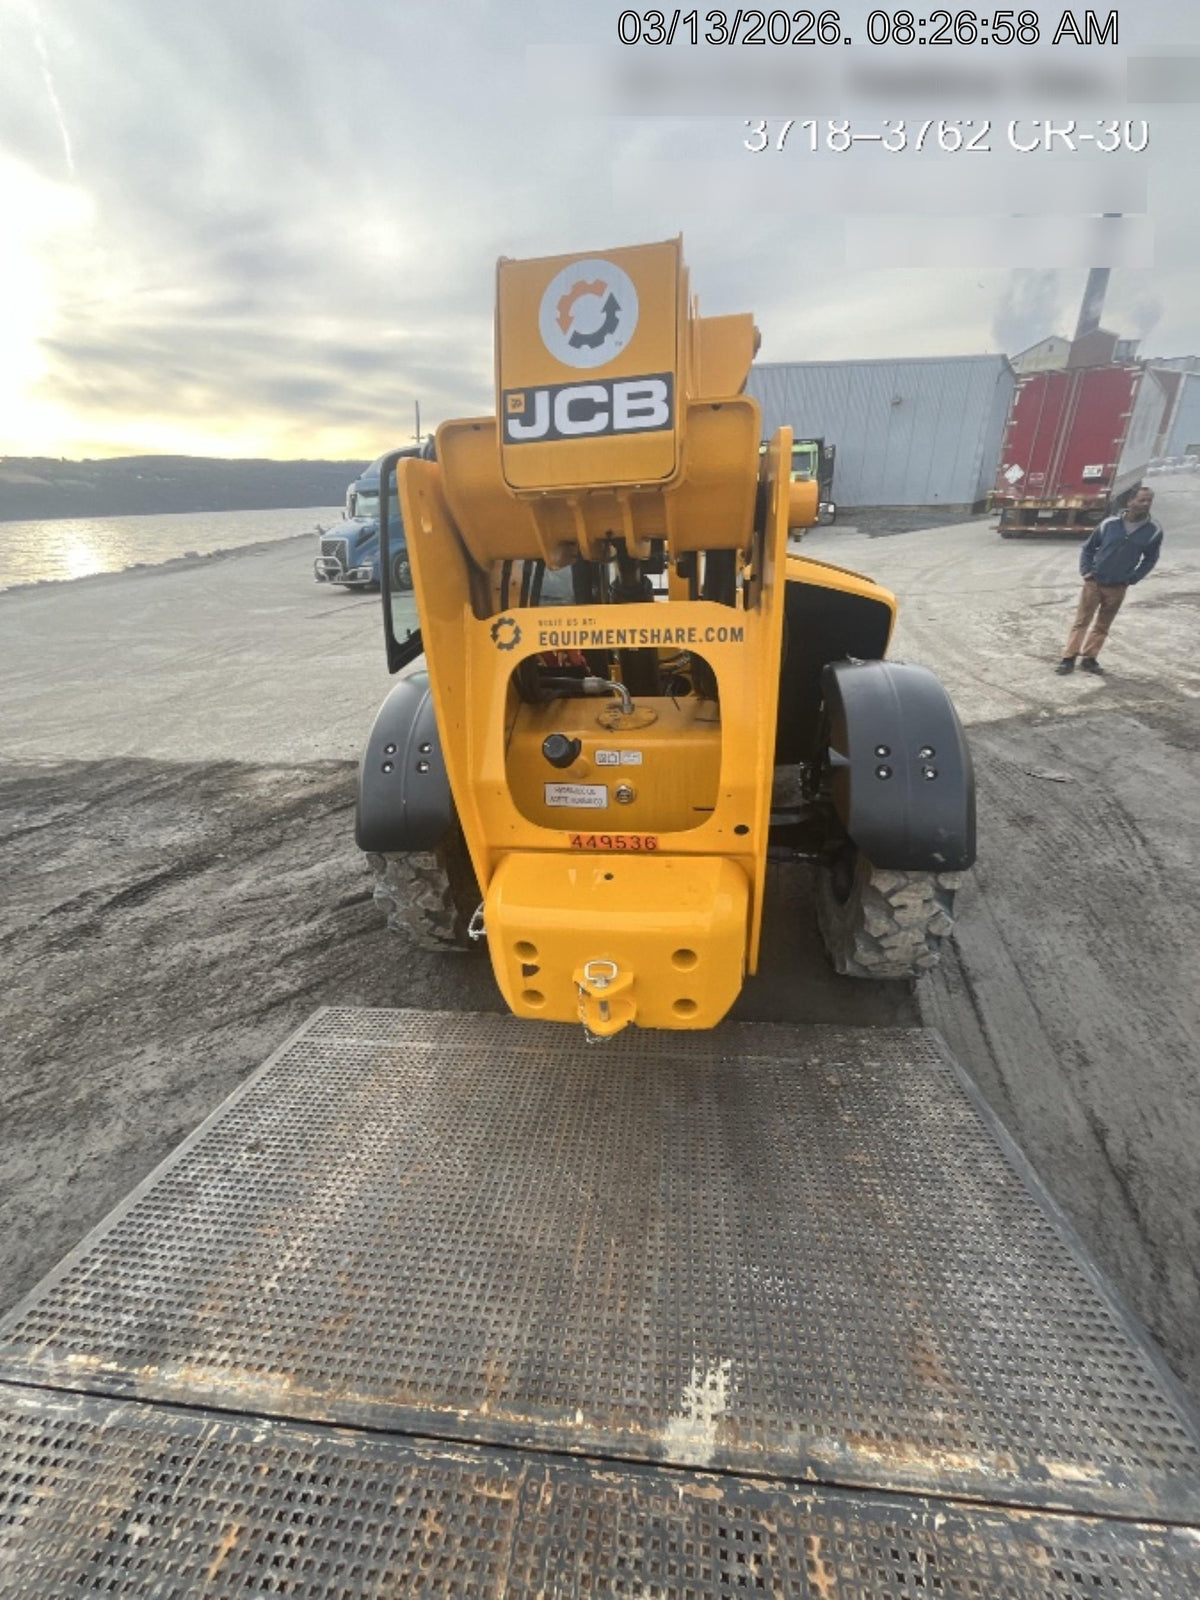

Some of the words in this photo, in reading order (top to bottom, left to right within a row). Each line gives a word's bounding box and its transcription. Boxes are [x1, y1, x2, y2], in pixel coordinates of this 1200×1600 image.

[507, 379, 669, 439] JCB
[539, 627, 744, 646] EQUIPMENTSHARE.COM
[571, 835, 657, 850] 449536
